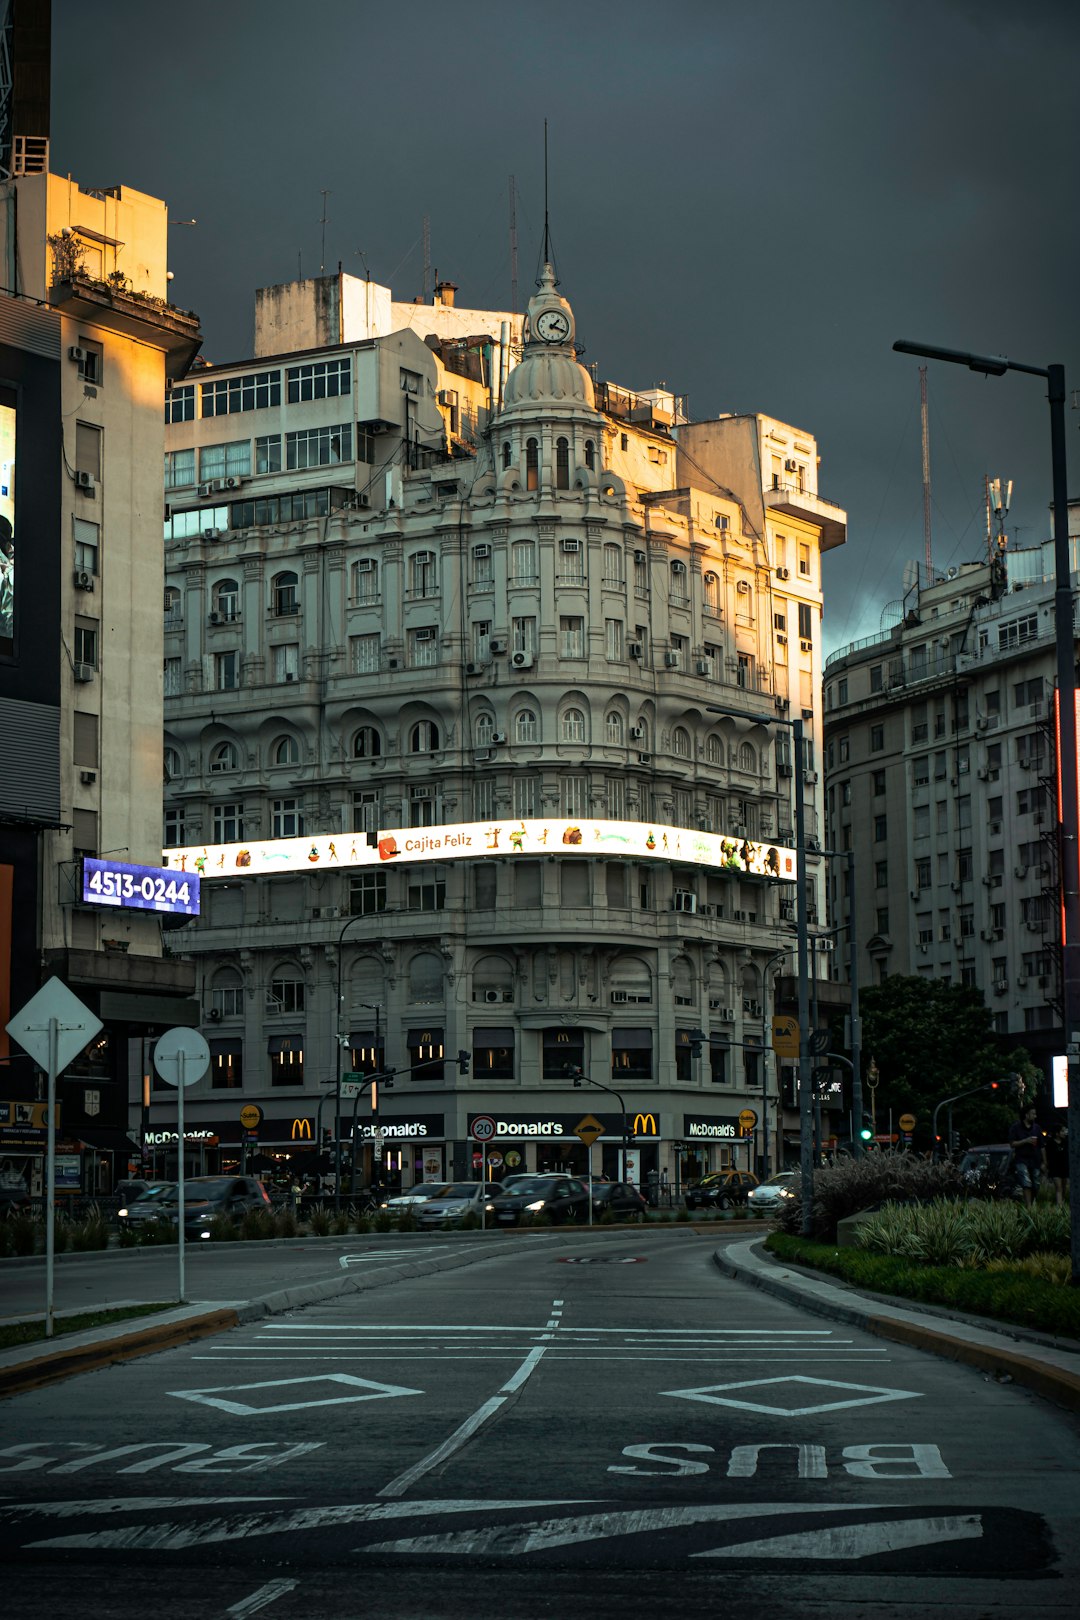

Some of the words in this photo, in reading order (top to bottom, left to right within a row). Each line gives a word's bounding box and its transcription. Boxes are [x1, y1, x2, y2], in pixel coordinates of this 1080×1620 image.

[405, 836, 441, 852] Cajita
[445, 833, 472, 846] Feliz
[89, 871, 190, 905] 4513-0244
[476, 1124, 492, 1135] 20
[496, 1121, 564, 1135] Donald's
[689, 1122, 736, 1137] McDonald's
[144, 1130, 215, 1145] McDoald's
[0, 1442, 327, 1474] BUS
[606, 1443, 953, 1480] BUS
